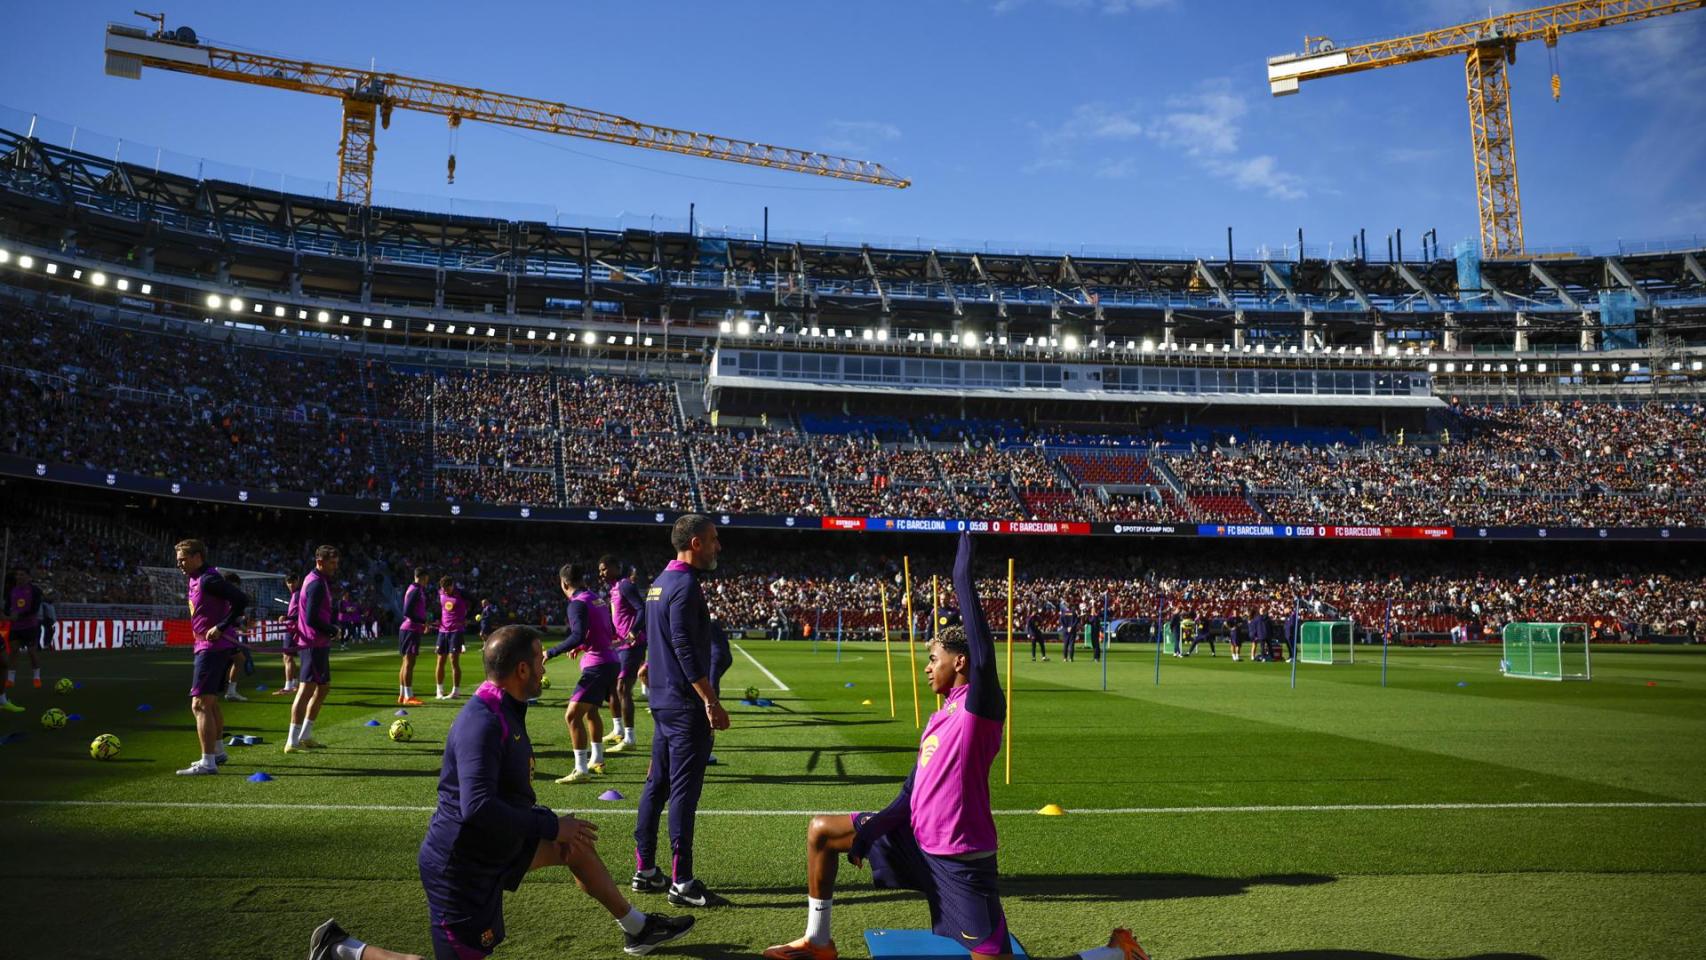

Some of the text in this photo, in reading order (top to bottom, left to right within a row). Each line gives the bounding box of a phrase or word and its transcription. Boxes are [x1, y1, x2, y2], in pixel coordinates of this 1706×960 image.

[897, 520, 1057, 532] FC BARCELONA 0 05:08 0 FC BARCELONA
[1227, 526, 1236, 535] FC
[1237, 526, 1274, 535] BARCELONA
[1285, 526, 1292, 536] 0
[1319, 527, 1325, 536] 0
[1335, 527, 1343, 536] FC
[1345, 527, 1381, 536] BARCELONA
[41, 620, 107, 651] RELLA
